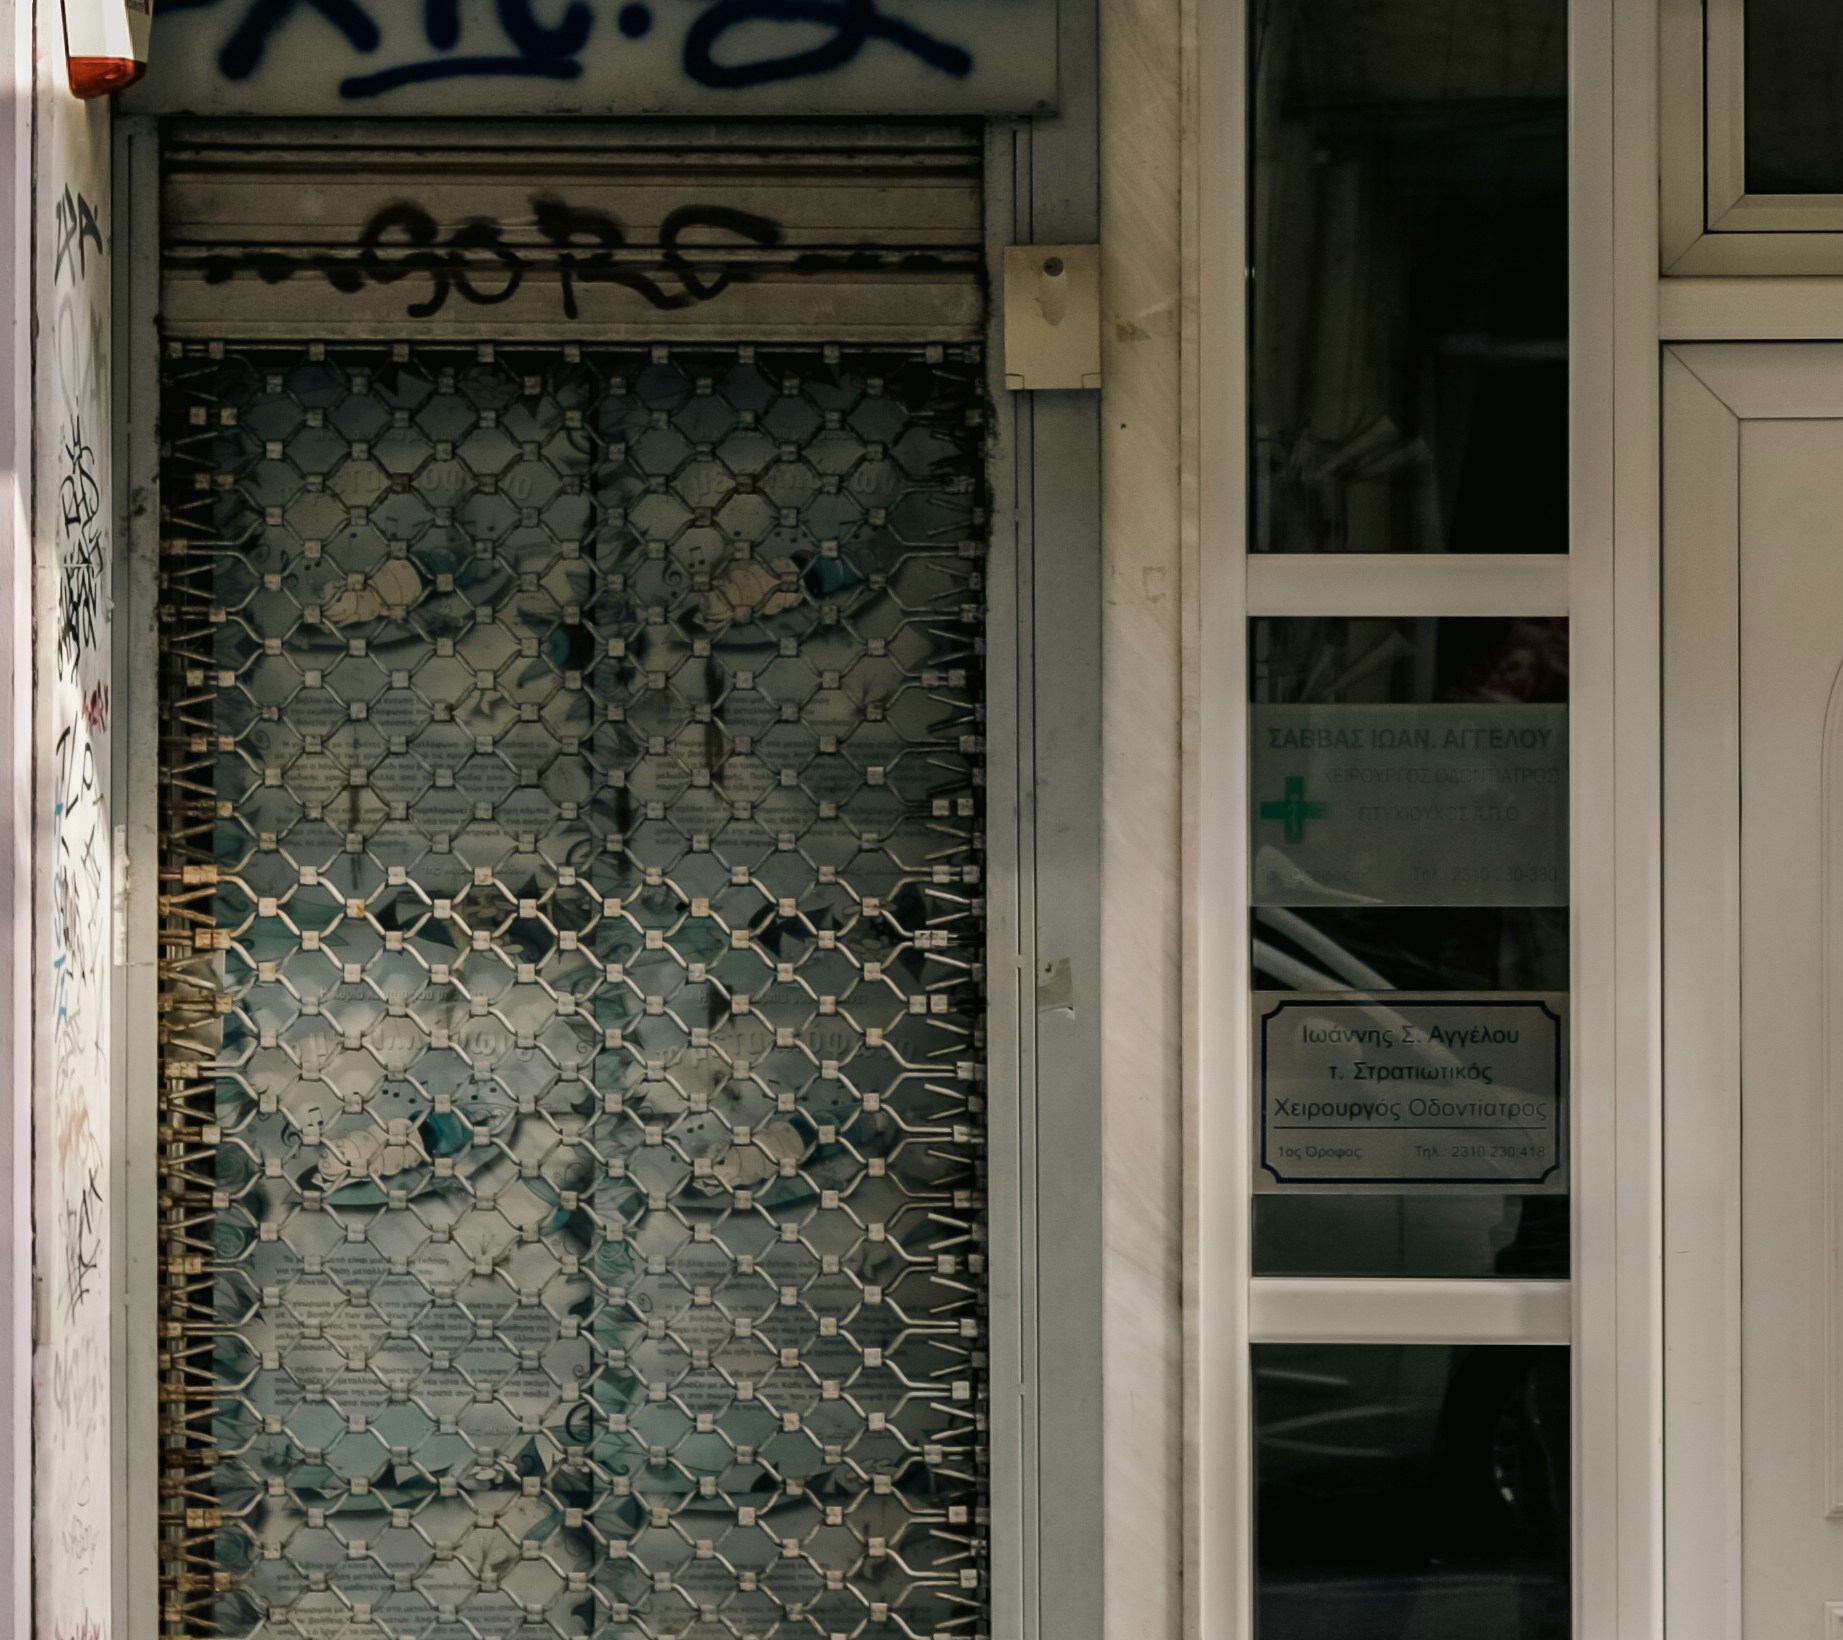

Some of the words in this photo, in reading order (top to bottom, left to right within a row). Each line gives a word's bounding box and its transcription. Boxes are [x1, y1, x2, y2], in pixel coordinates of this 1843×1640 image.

[1268, 727, 1363, 750] ΣΑΒΒΑΣ
[1444, 727, 1553, 750] ΑΓΓΕΛΟΥ
[1302, 1024, 1393, 1048] Ιωάννης
[1401, 1025, 1421, 1045] Σ.
[1428, 1024, 1520, 1048] Αγγέλου
[1353, 1061, 1493, 1084] Στρατιωτικός
[1274, 1097, 1400, 1121] Χειρουργός
[1408, 1097, 1547, 1121] Οδοντίατρος
